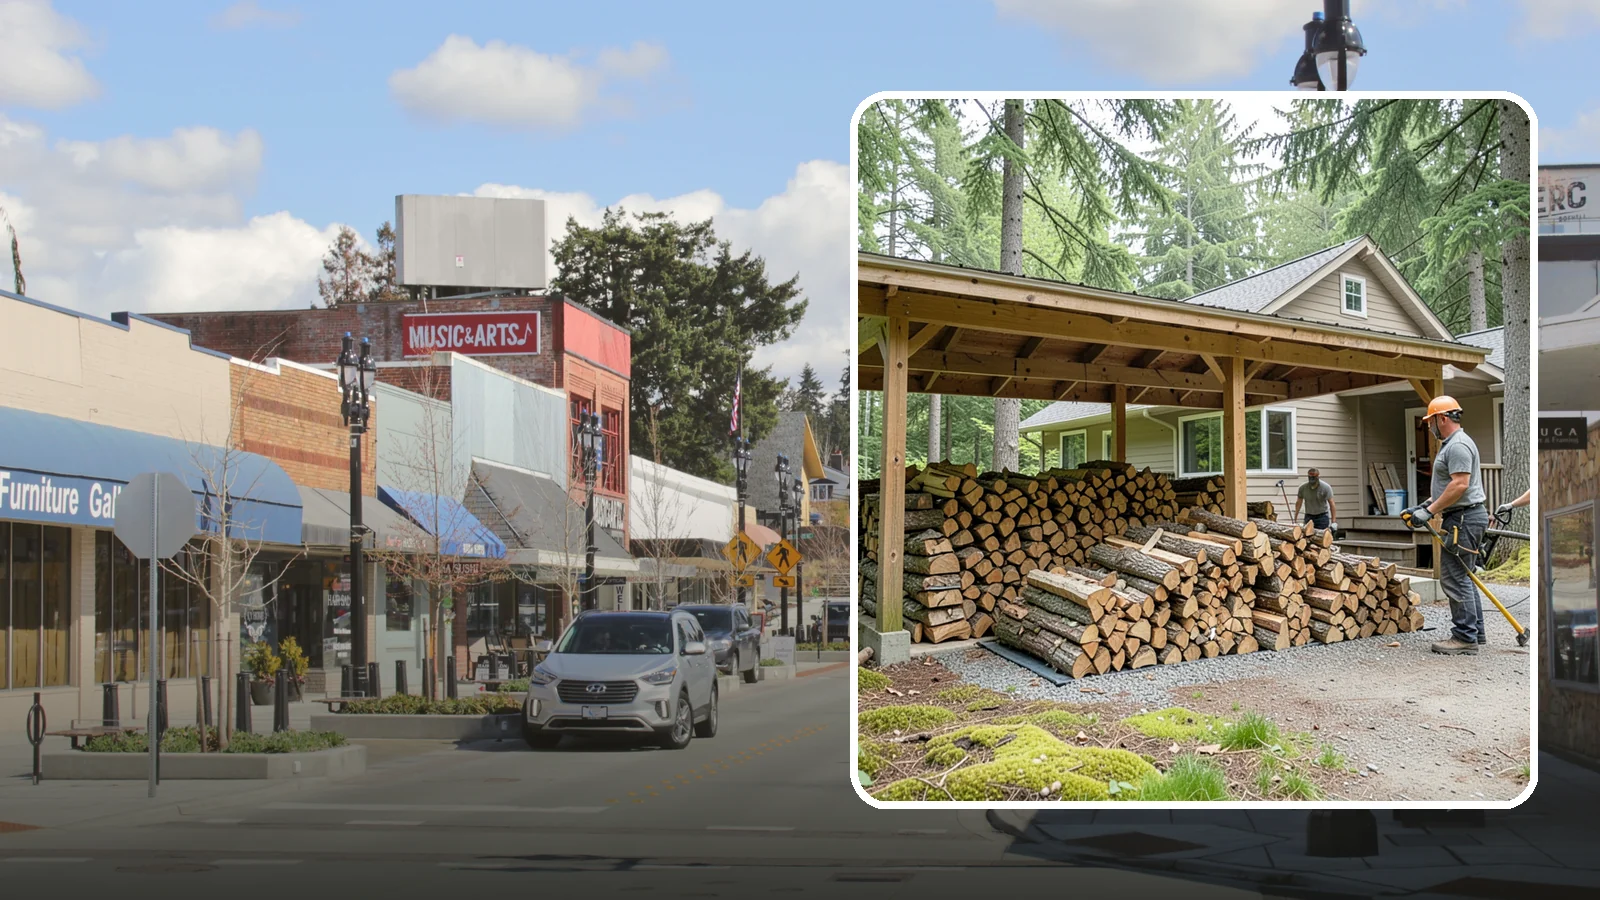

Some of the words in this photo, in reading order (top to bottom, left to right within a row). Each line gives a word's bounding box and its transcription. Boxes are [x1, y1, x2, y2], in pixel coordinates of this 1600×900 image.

[408, 322, 520, 349] MUSIC&ARTS
[1540, 427, 1577, 436] UGA
[0, 471, 79, 516] Furniture
[89, 482, 122, 519] Gal
[453, 563, 479, 574] SUSHI
